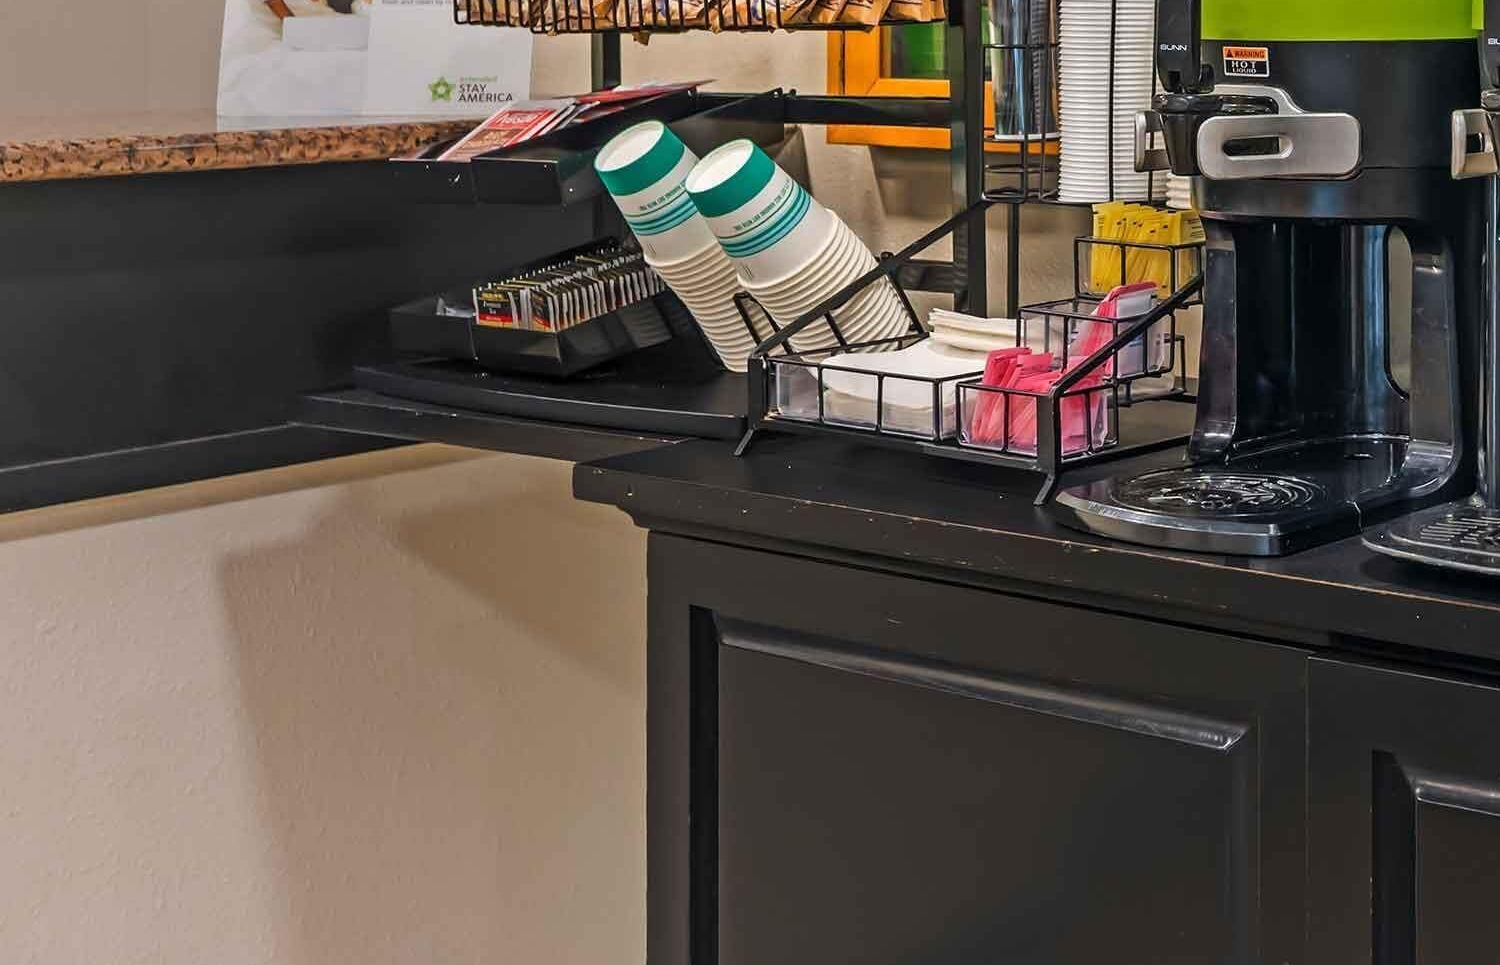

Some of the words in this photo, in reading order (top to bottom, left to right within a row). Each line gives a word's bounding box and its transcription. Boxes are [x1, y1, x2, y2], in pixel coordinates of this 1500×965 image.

[1159, 43, 1188, 51] BUNN
[1234, 50, 1265, 59] WARNING
[1231, 60, 1257, 69] HOT
[458, 83, 488, 93] STAY
[457, 92, 514, 103] AMERICA
